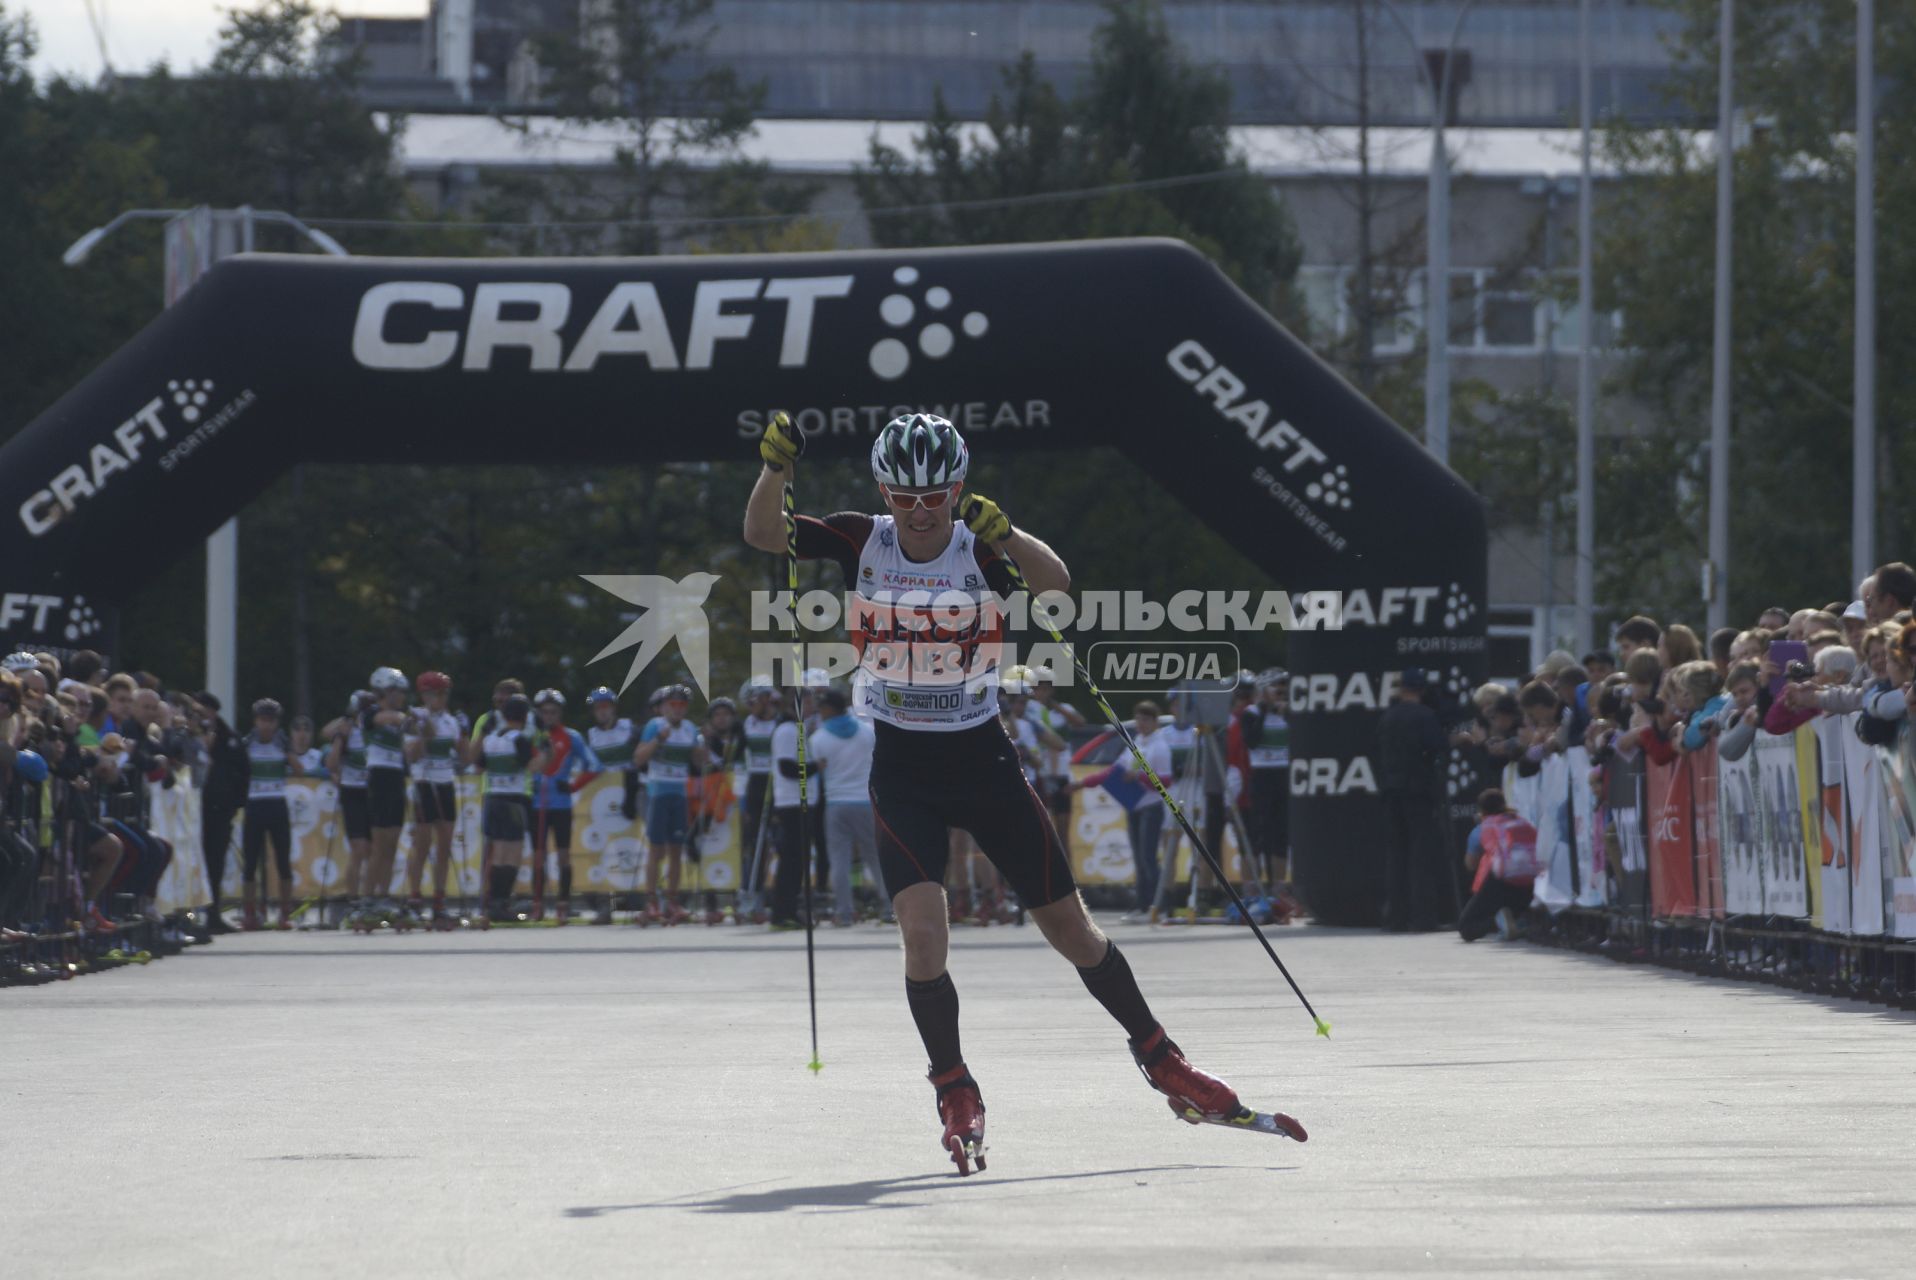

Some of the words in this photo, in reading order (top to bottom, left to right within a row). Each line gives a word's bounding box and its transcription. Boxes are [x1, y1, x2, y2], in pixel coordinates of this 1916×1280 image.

[352, 275, 855, 371] CRAFT
[158, 388, 257, 472] SPORTSWEAR
[736, 400, 1051, 438] SORTSWEAR
[1166, 339, 1329, 472] CRAFT
[19, 396, 168, 537] CRAFT
[1252, 466, 1347, 551] SPORTSWEAR
[932, 693, 960, 709] 100
[1290, 671, 1440, 711] CRAF
[1290, 756, 1378, 795] CRA
